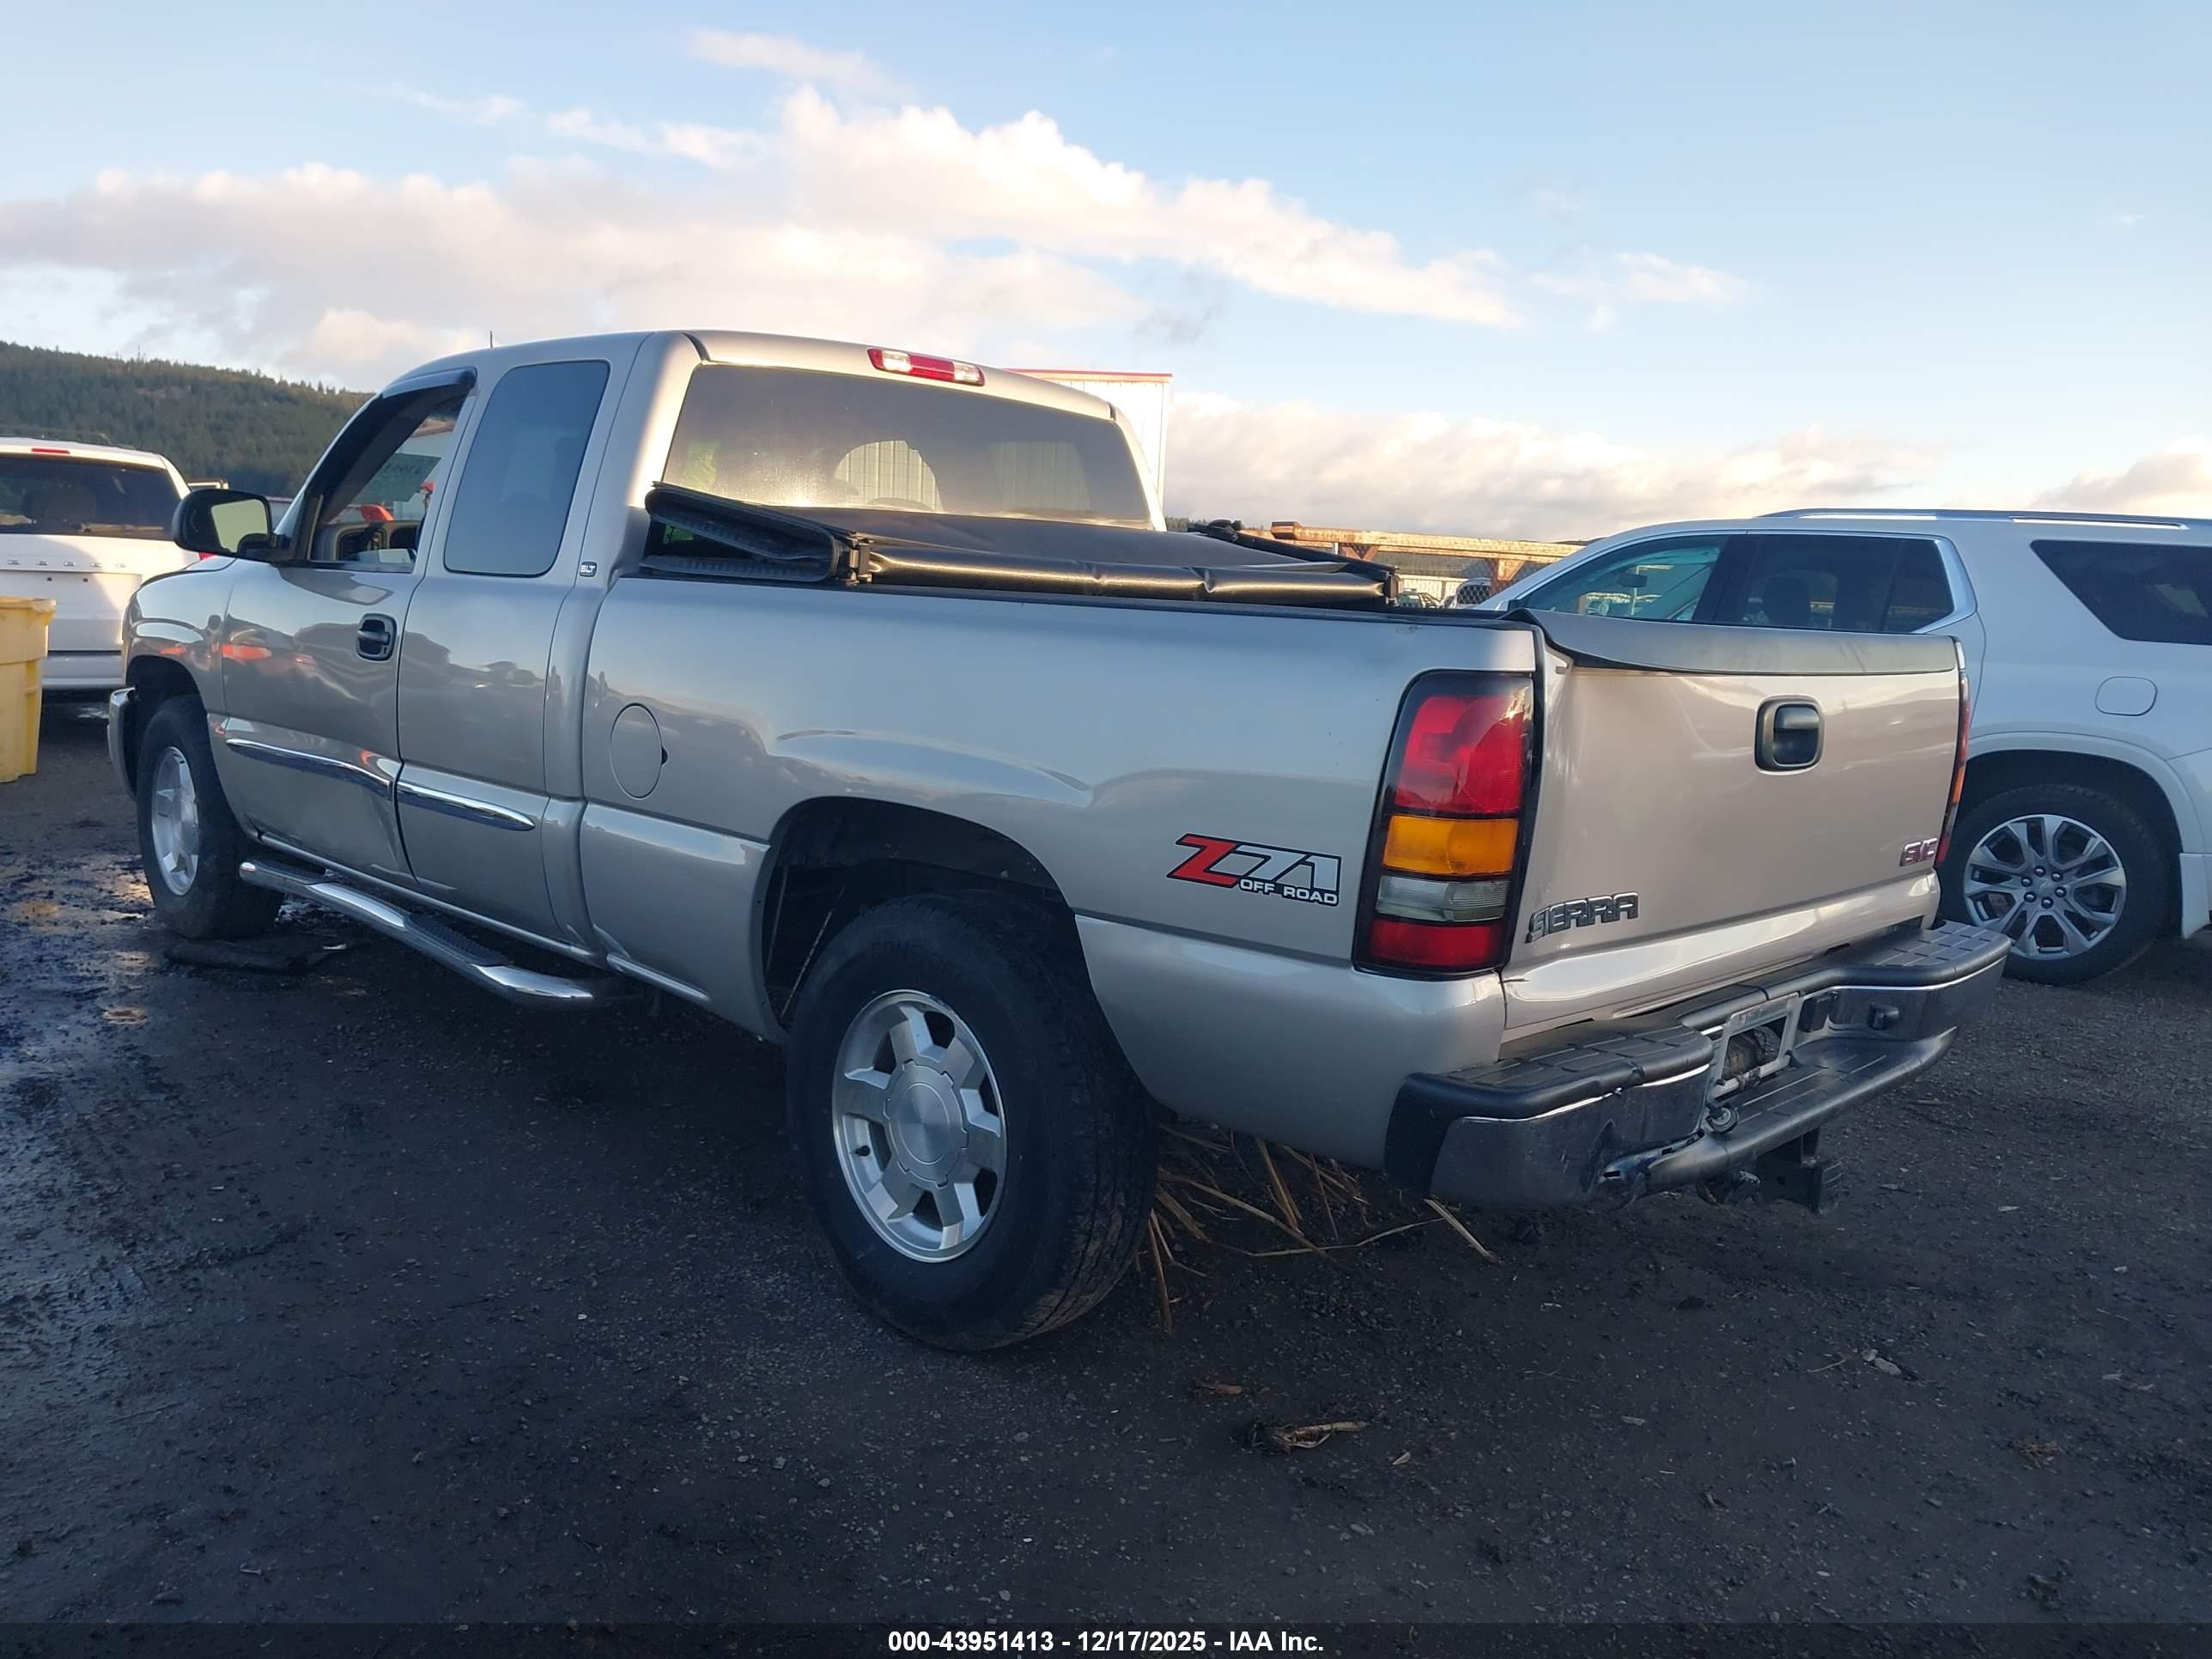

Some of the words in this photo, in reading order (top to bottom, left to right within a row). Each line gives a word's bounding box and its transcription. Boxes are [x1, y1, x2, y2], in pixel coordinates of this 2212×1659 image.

[580, 563, 596, 574] SLT
[1167, 833, 1342, 892] Z71
[1239, 878, 1275, 895] OFF
[1283, 885, 1339, 905] ROAD
[1525, 891, 1639, 944] SIERRA
